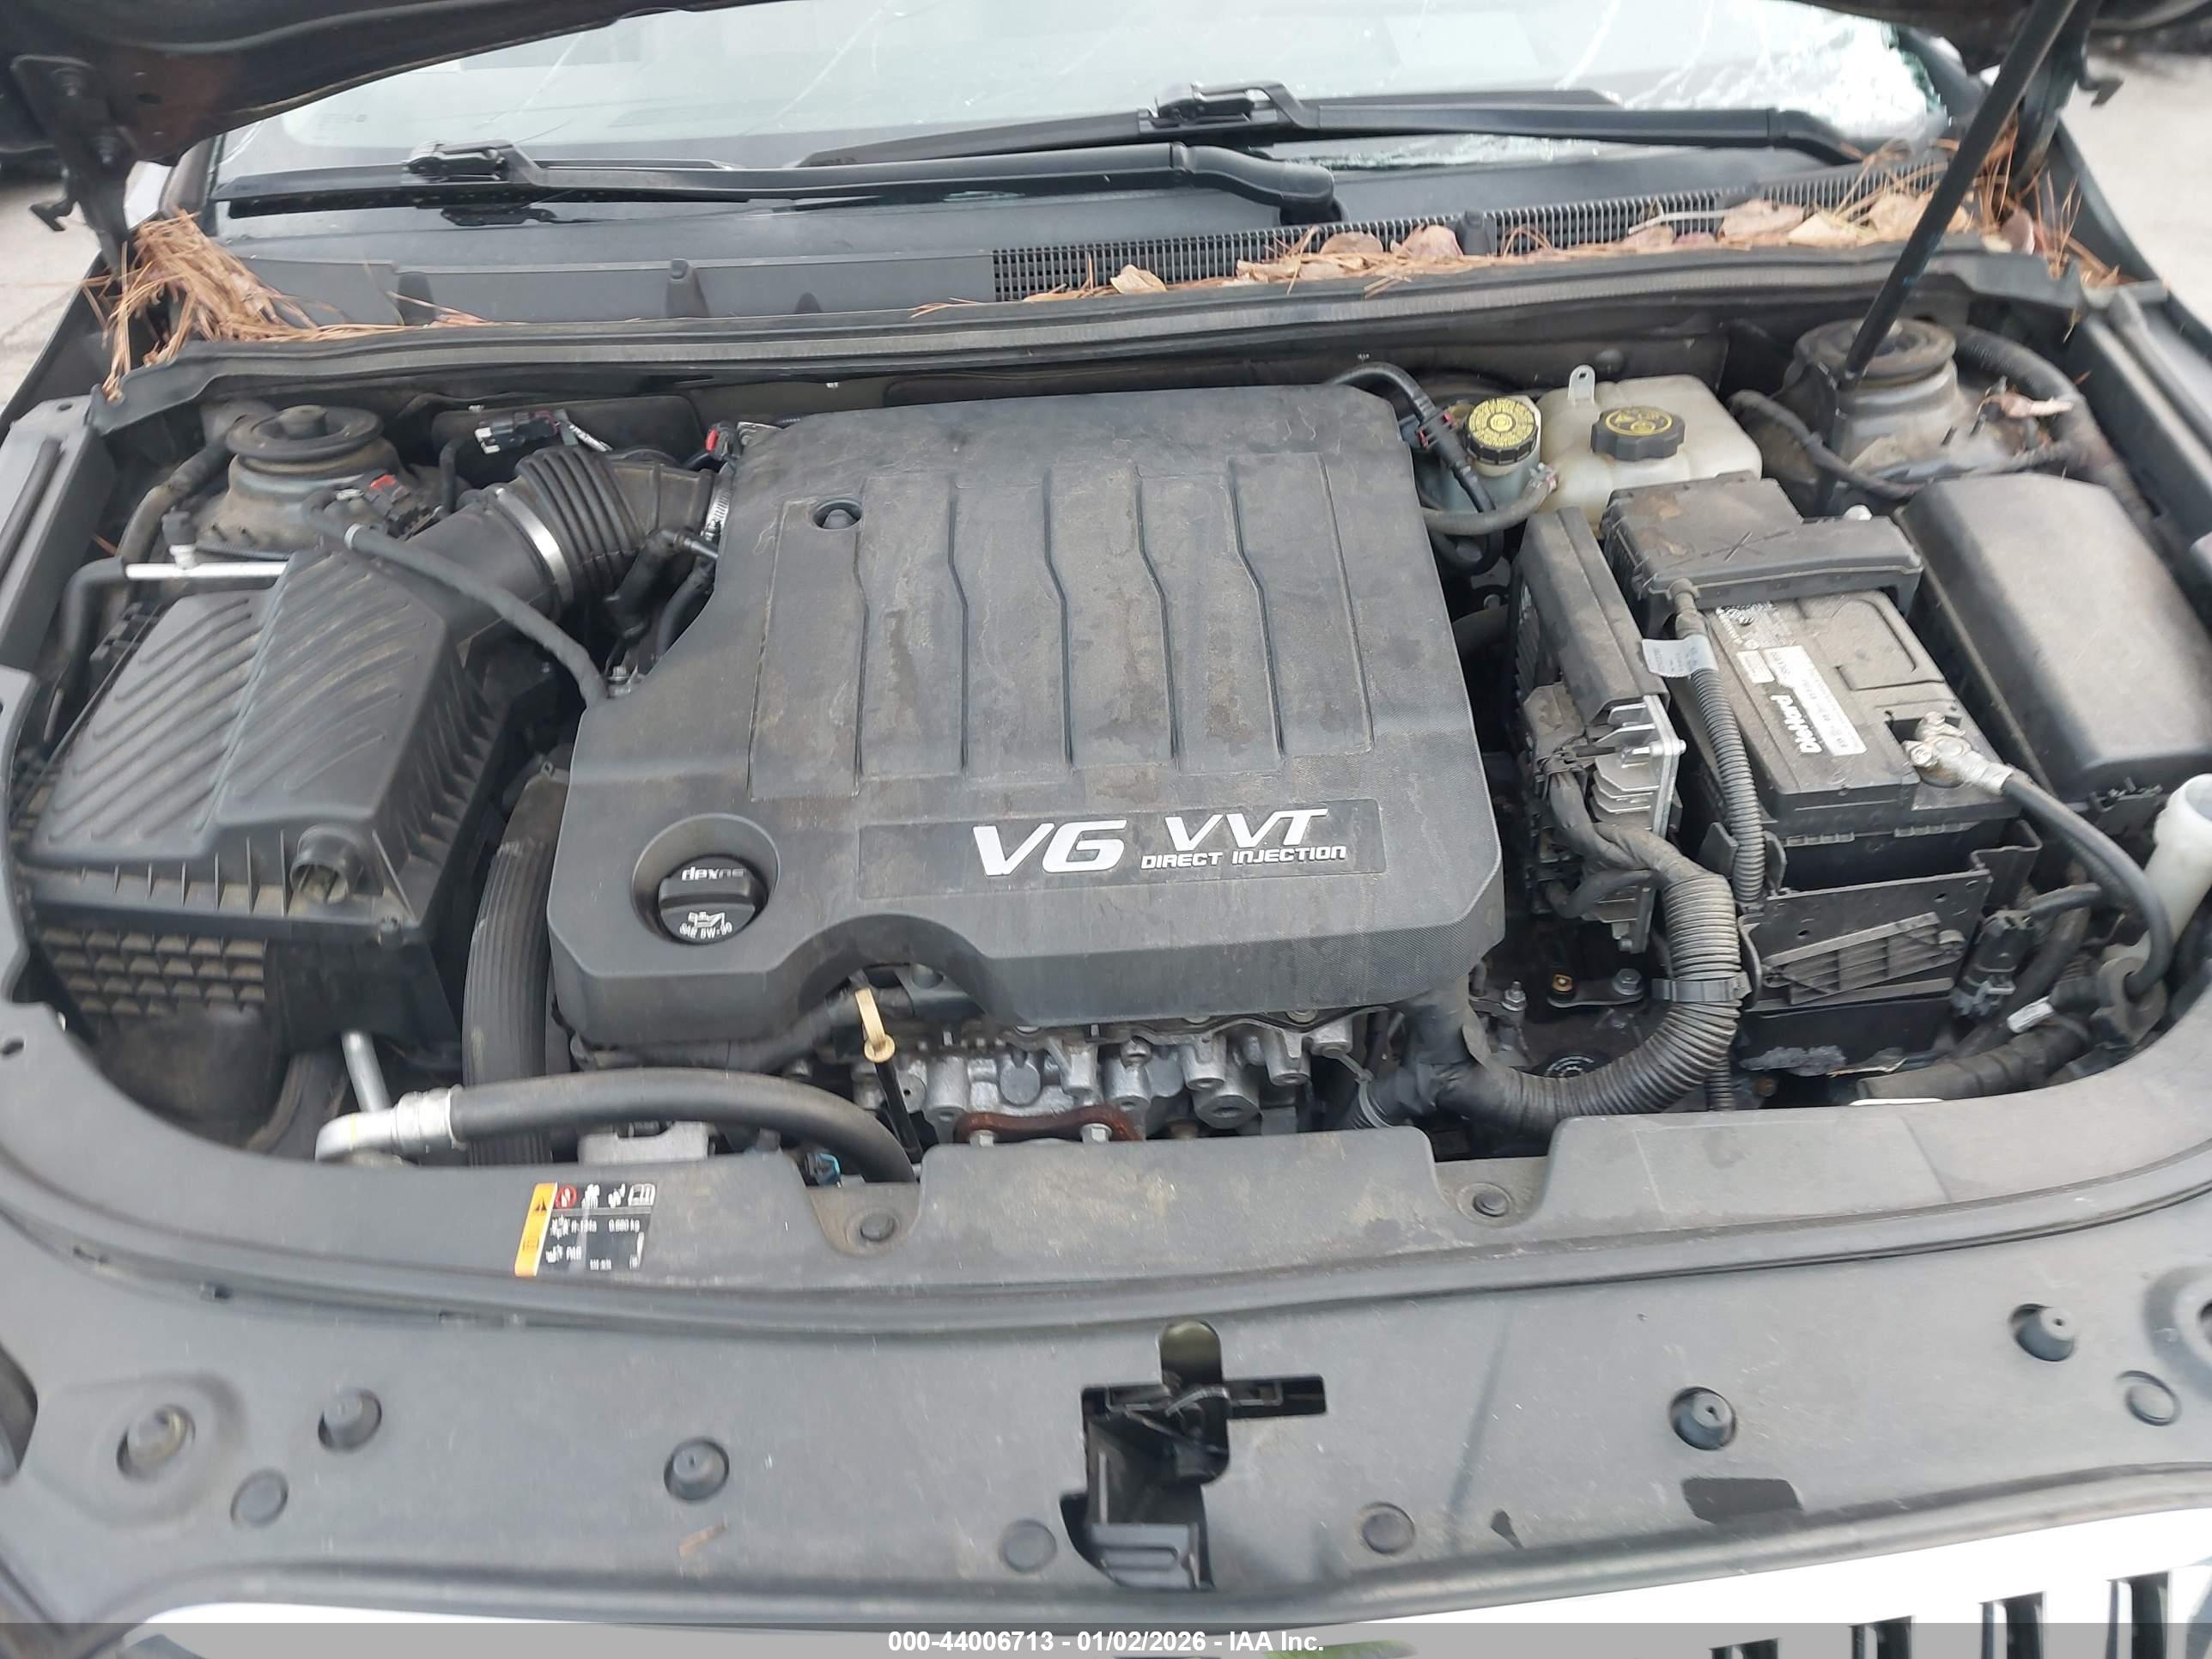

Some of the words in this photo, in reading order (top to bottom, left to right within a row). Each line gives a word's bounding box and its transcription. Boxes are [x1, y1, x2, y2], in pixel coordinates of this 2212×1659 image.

[1770, 694, 1823, 753] DieHard
[972, 818, 1127, 877] V6
[1164, 808, 1329, 851] VVT
[1139, 850, 1224, 870] DIRECT
[1231, 845, 1346, 866] INJECTION
